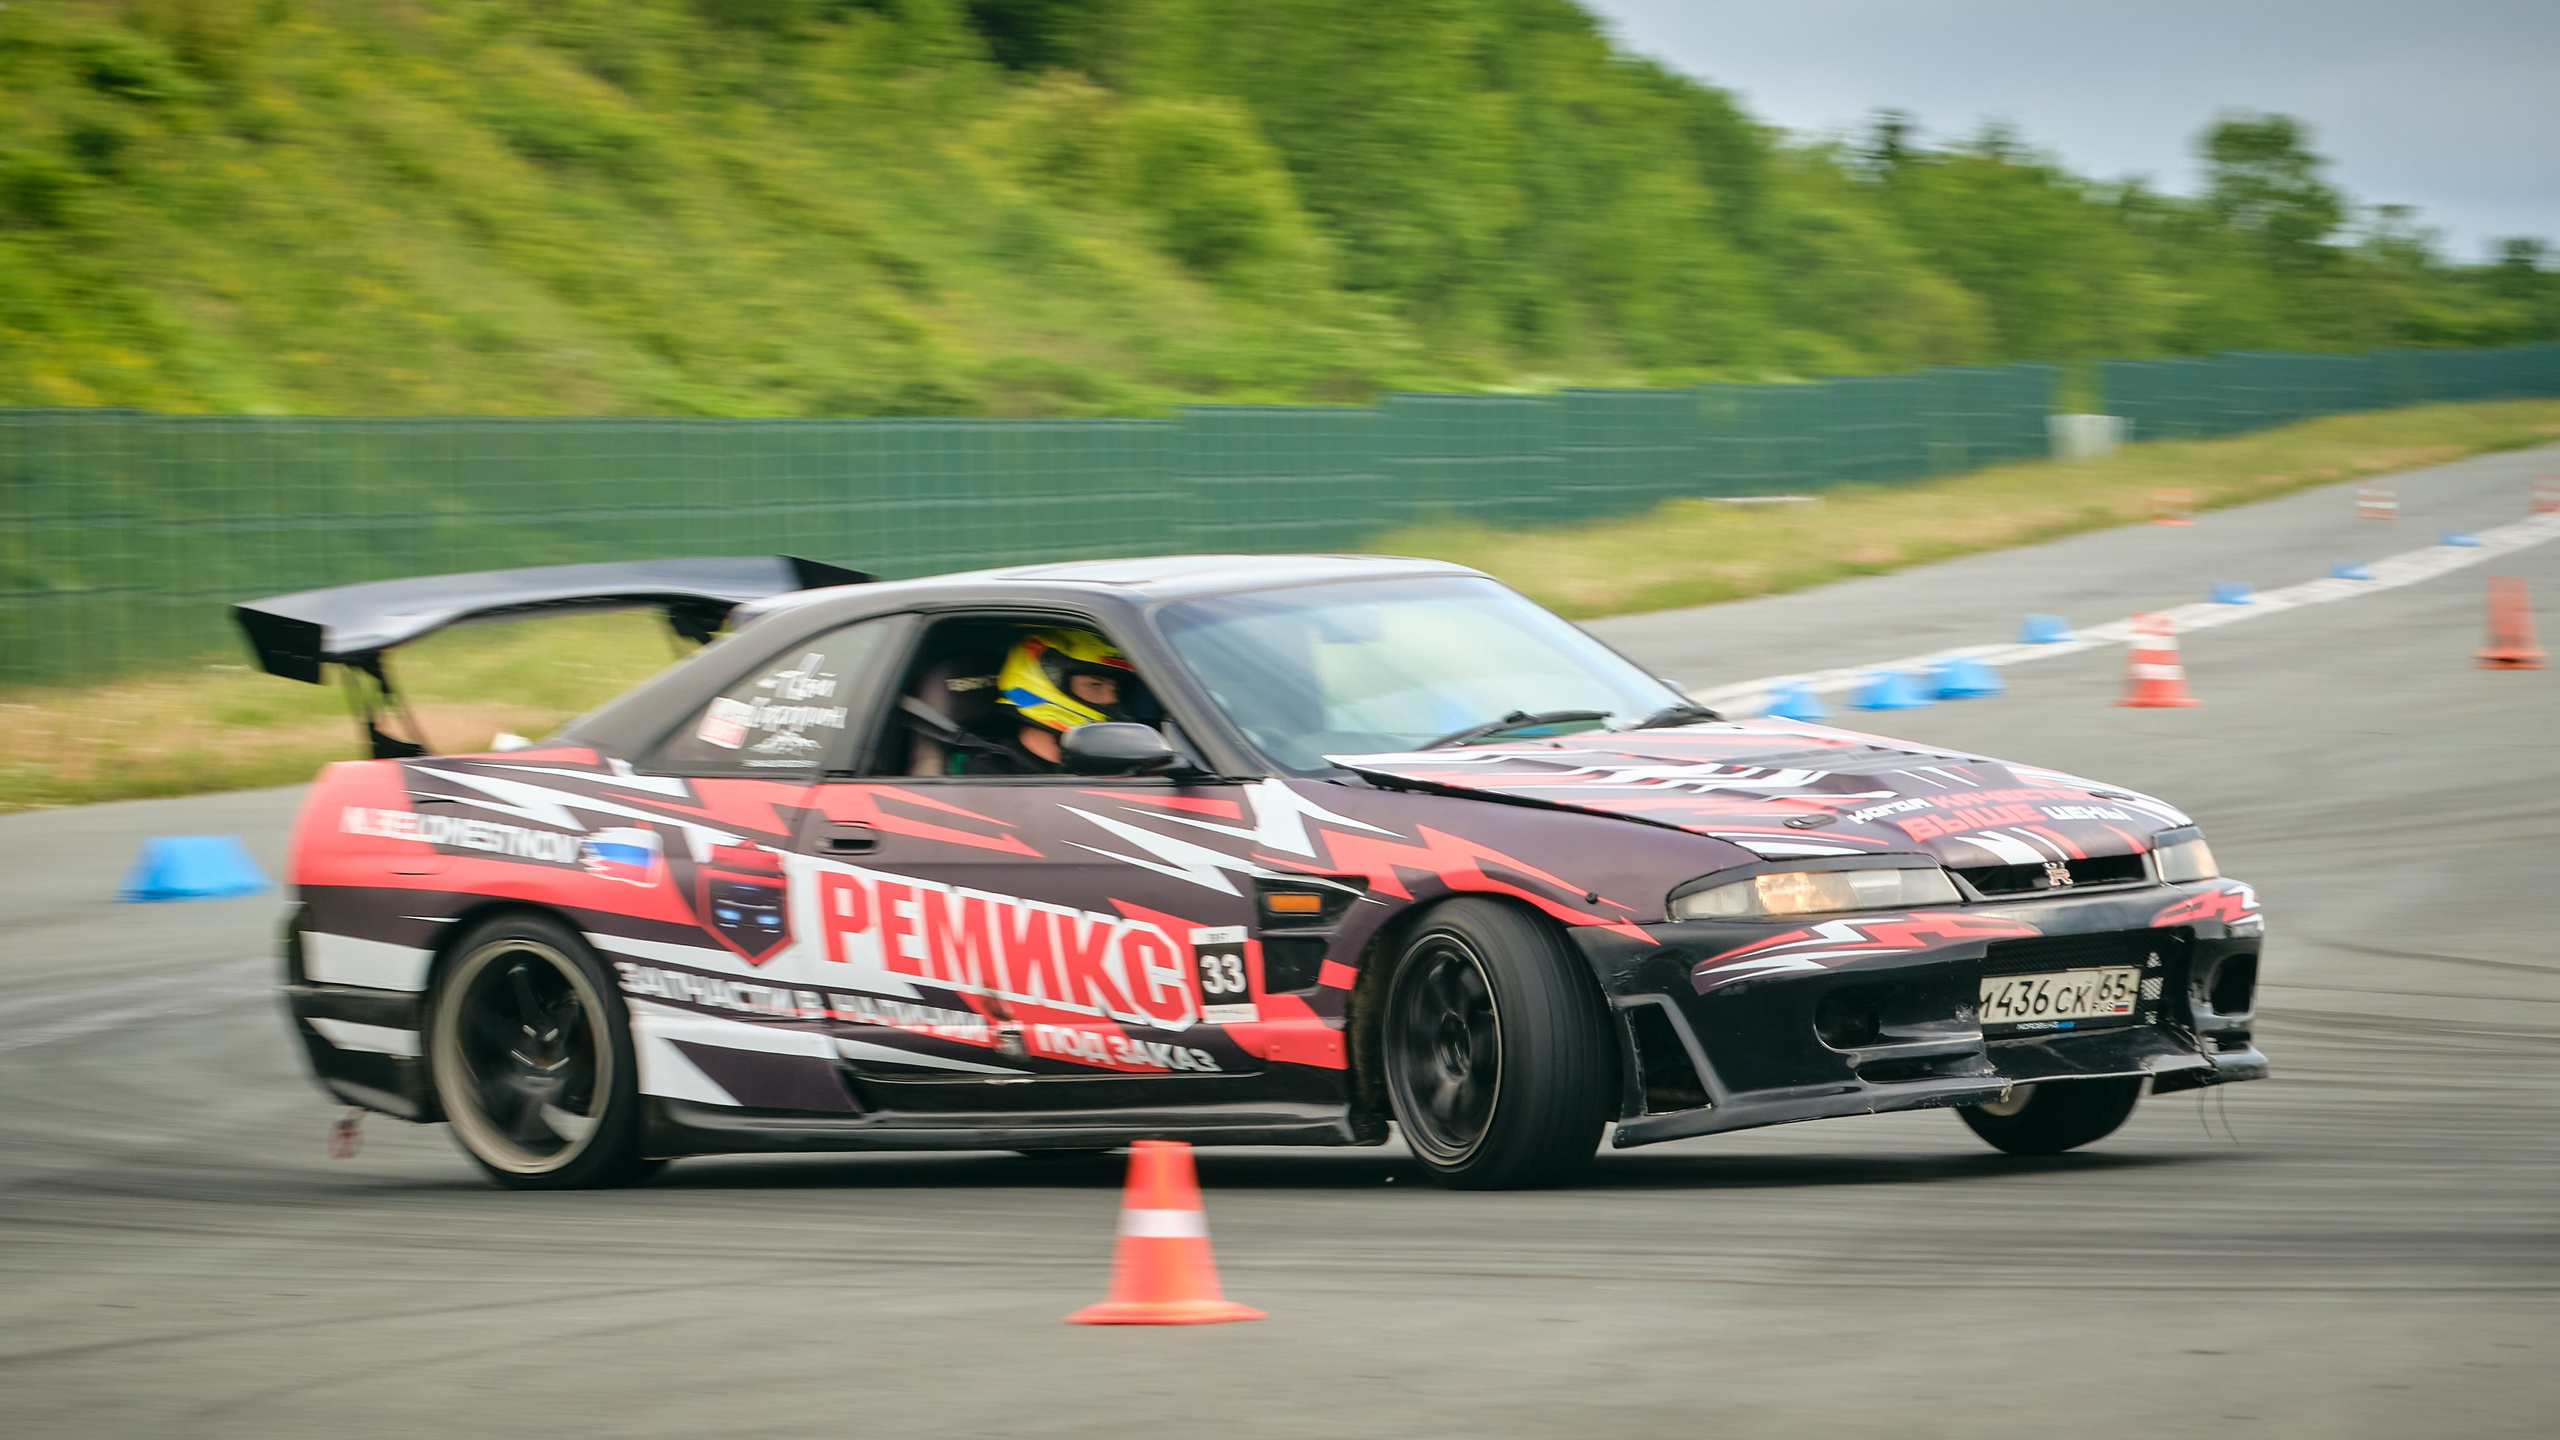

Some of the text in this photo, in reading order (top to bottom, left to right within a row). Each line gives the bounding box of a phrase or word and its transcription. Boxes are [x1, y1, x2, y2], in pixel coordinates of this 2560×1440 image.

[1846, 797, 1934, 825] КОГДА
[1896, 803, 2133, 842] ВЫШЕ ЦЕНЫ
[816, 869, 1190, 1026] РЕМИКС
[1200, 953, 1247, 994] 33
[2100, 973, 2129, 1001] 65
[612, 961, 797, 1017] ЗАПЧАСТИ
[1034, 1024, 1114, 1065] ПОД
[1107, 1036, 1223, 1073] ЗАКАЗ
